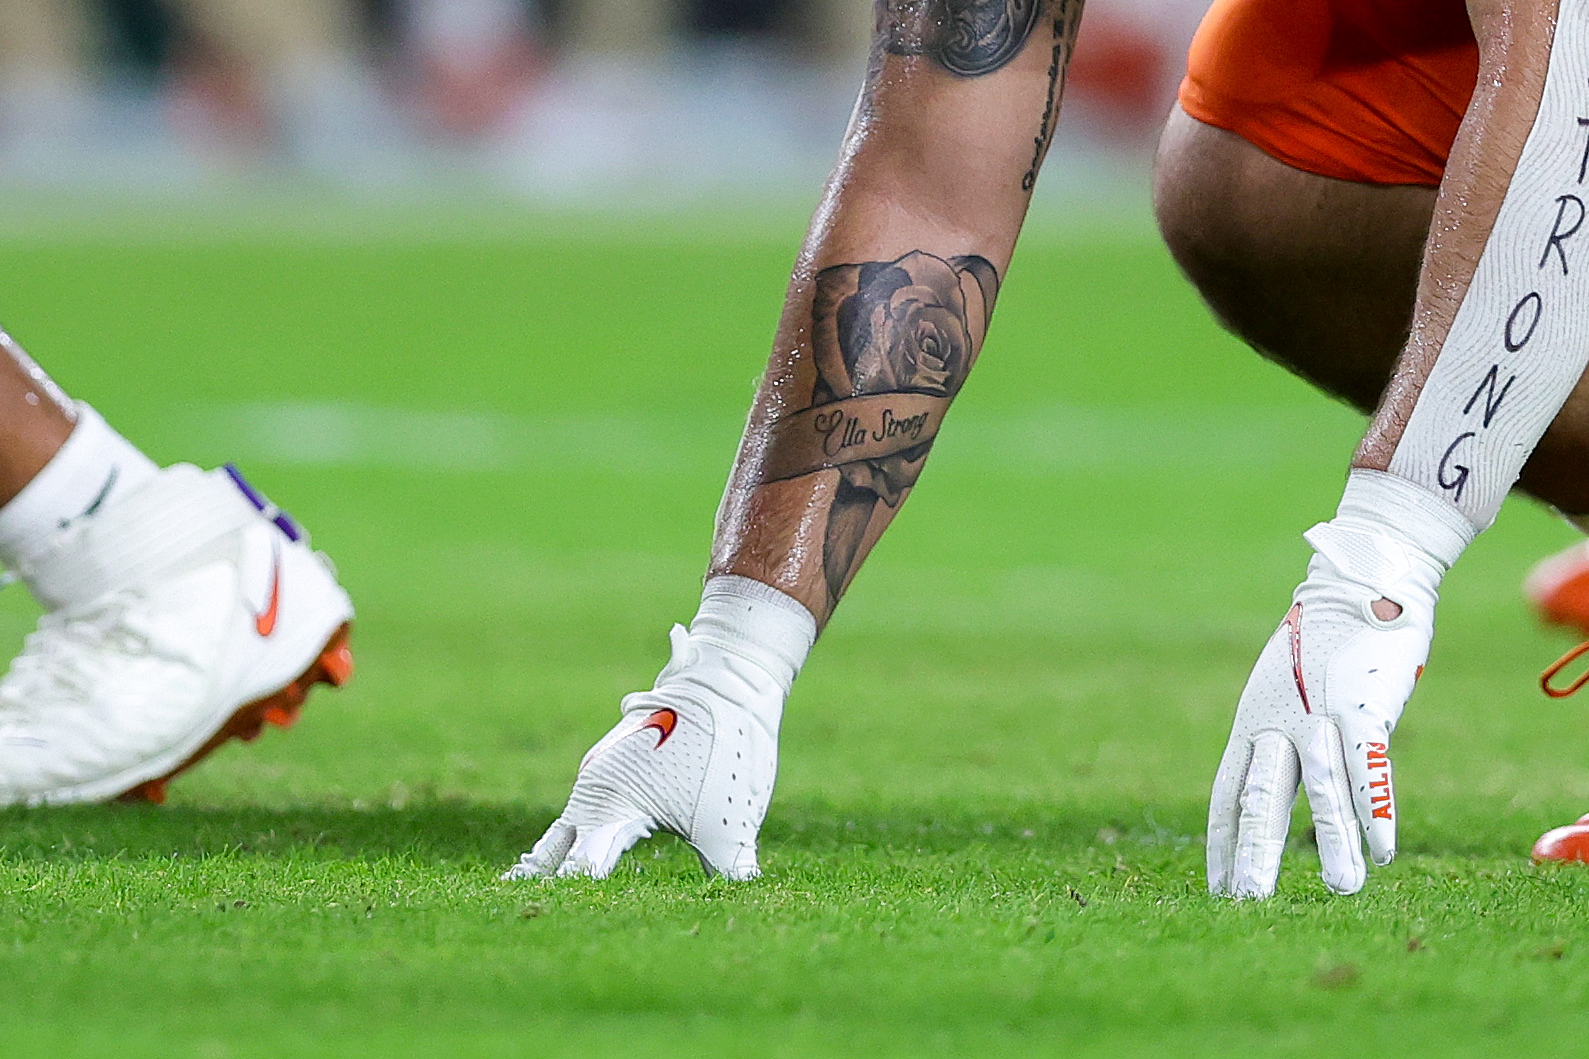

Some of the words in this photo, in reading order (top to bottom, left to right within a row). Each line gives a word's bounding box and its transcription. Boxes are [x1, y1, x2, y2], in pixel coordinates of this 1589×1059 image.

[814, 409, 866, 458] Ella
[872, 408, 929, 442] Strong
[1368, 772, 1393, 821] ALL
